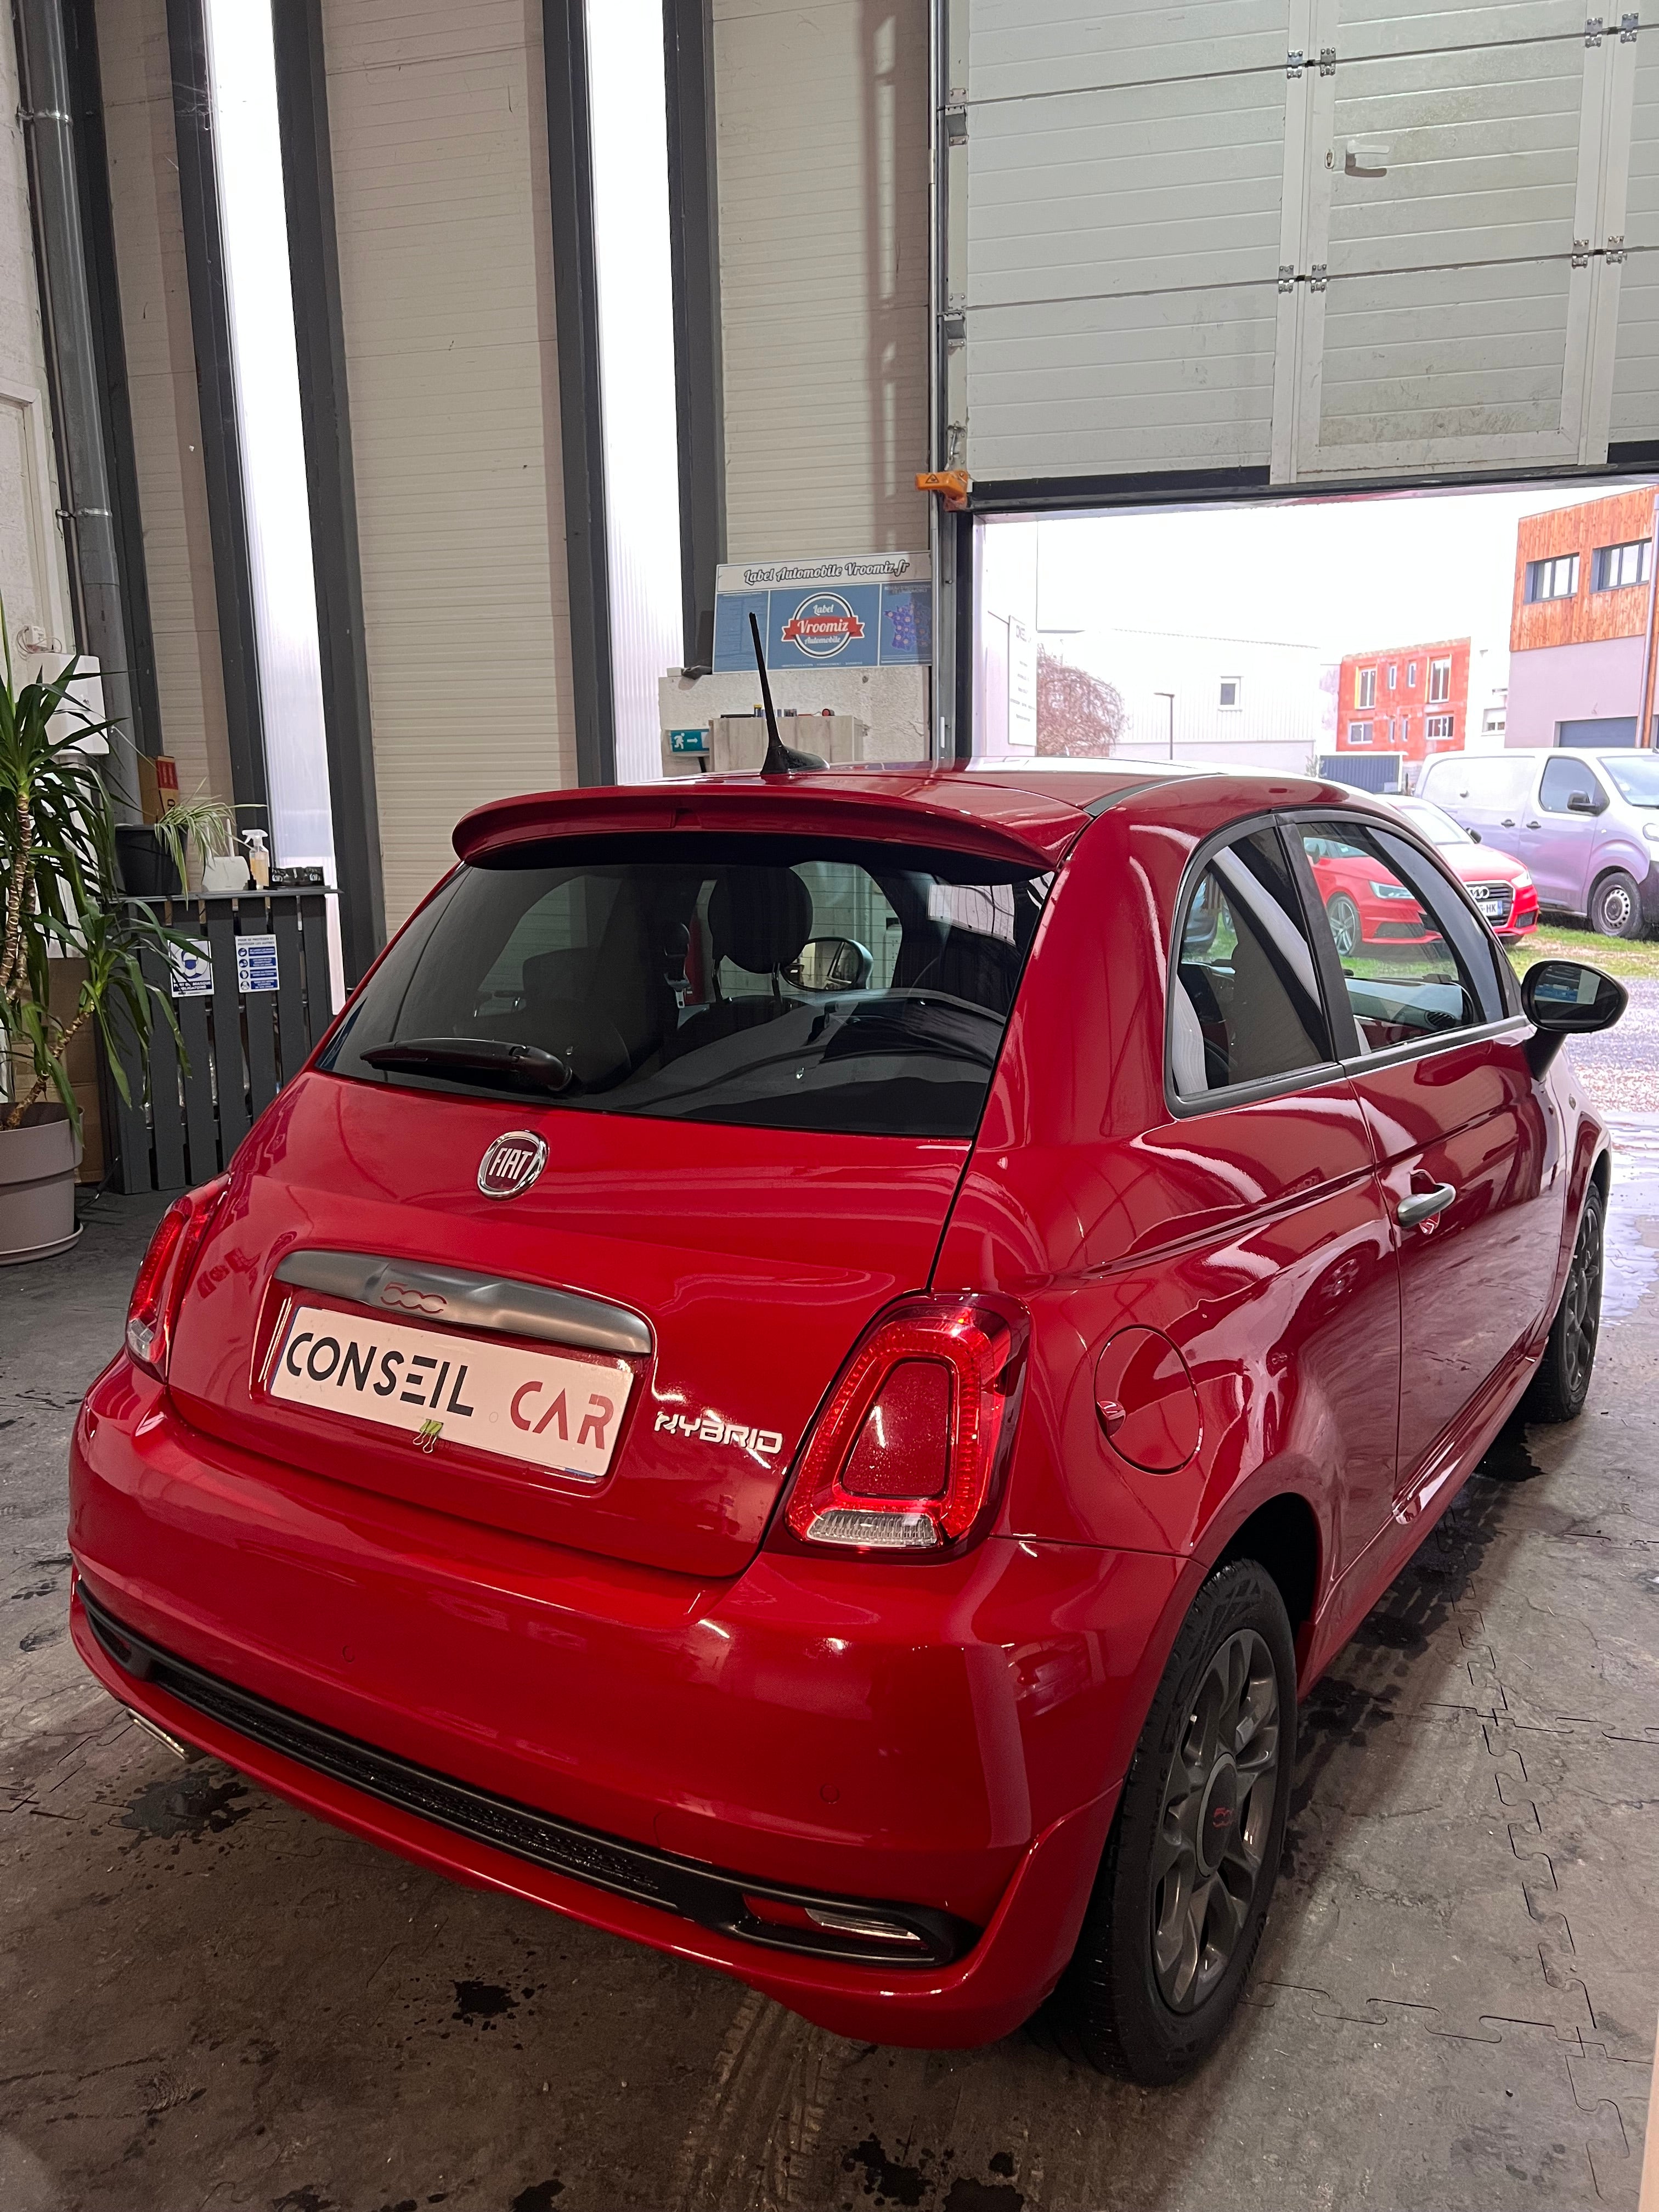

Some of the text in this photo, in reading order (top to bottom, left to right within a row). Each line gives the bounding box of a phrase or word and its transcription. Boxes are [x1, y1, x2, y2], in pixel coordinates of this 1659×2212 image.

[744, 559, 910, 585] Label Automobile Vroomiz.fr
[812, 604, 834, 616] Label
[797, 618, 849, 634] Vroomiz
[804, 635, 840, 645] Automobile
[488, 1147, 533, 1180] FIAT
[380, 1282, 447, 1314] 500
[286, 1332, 615, 1450] CONSEIL CAR
[654, 1411, 783, 1454] HYBRID
